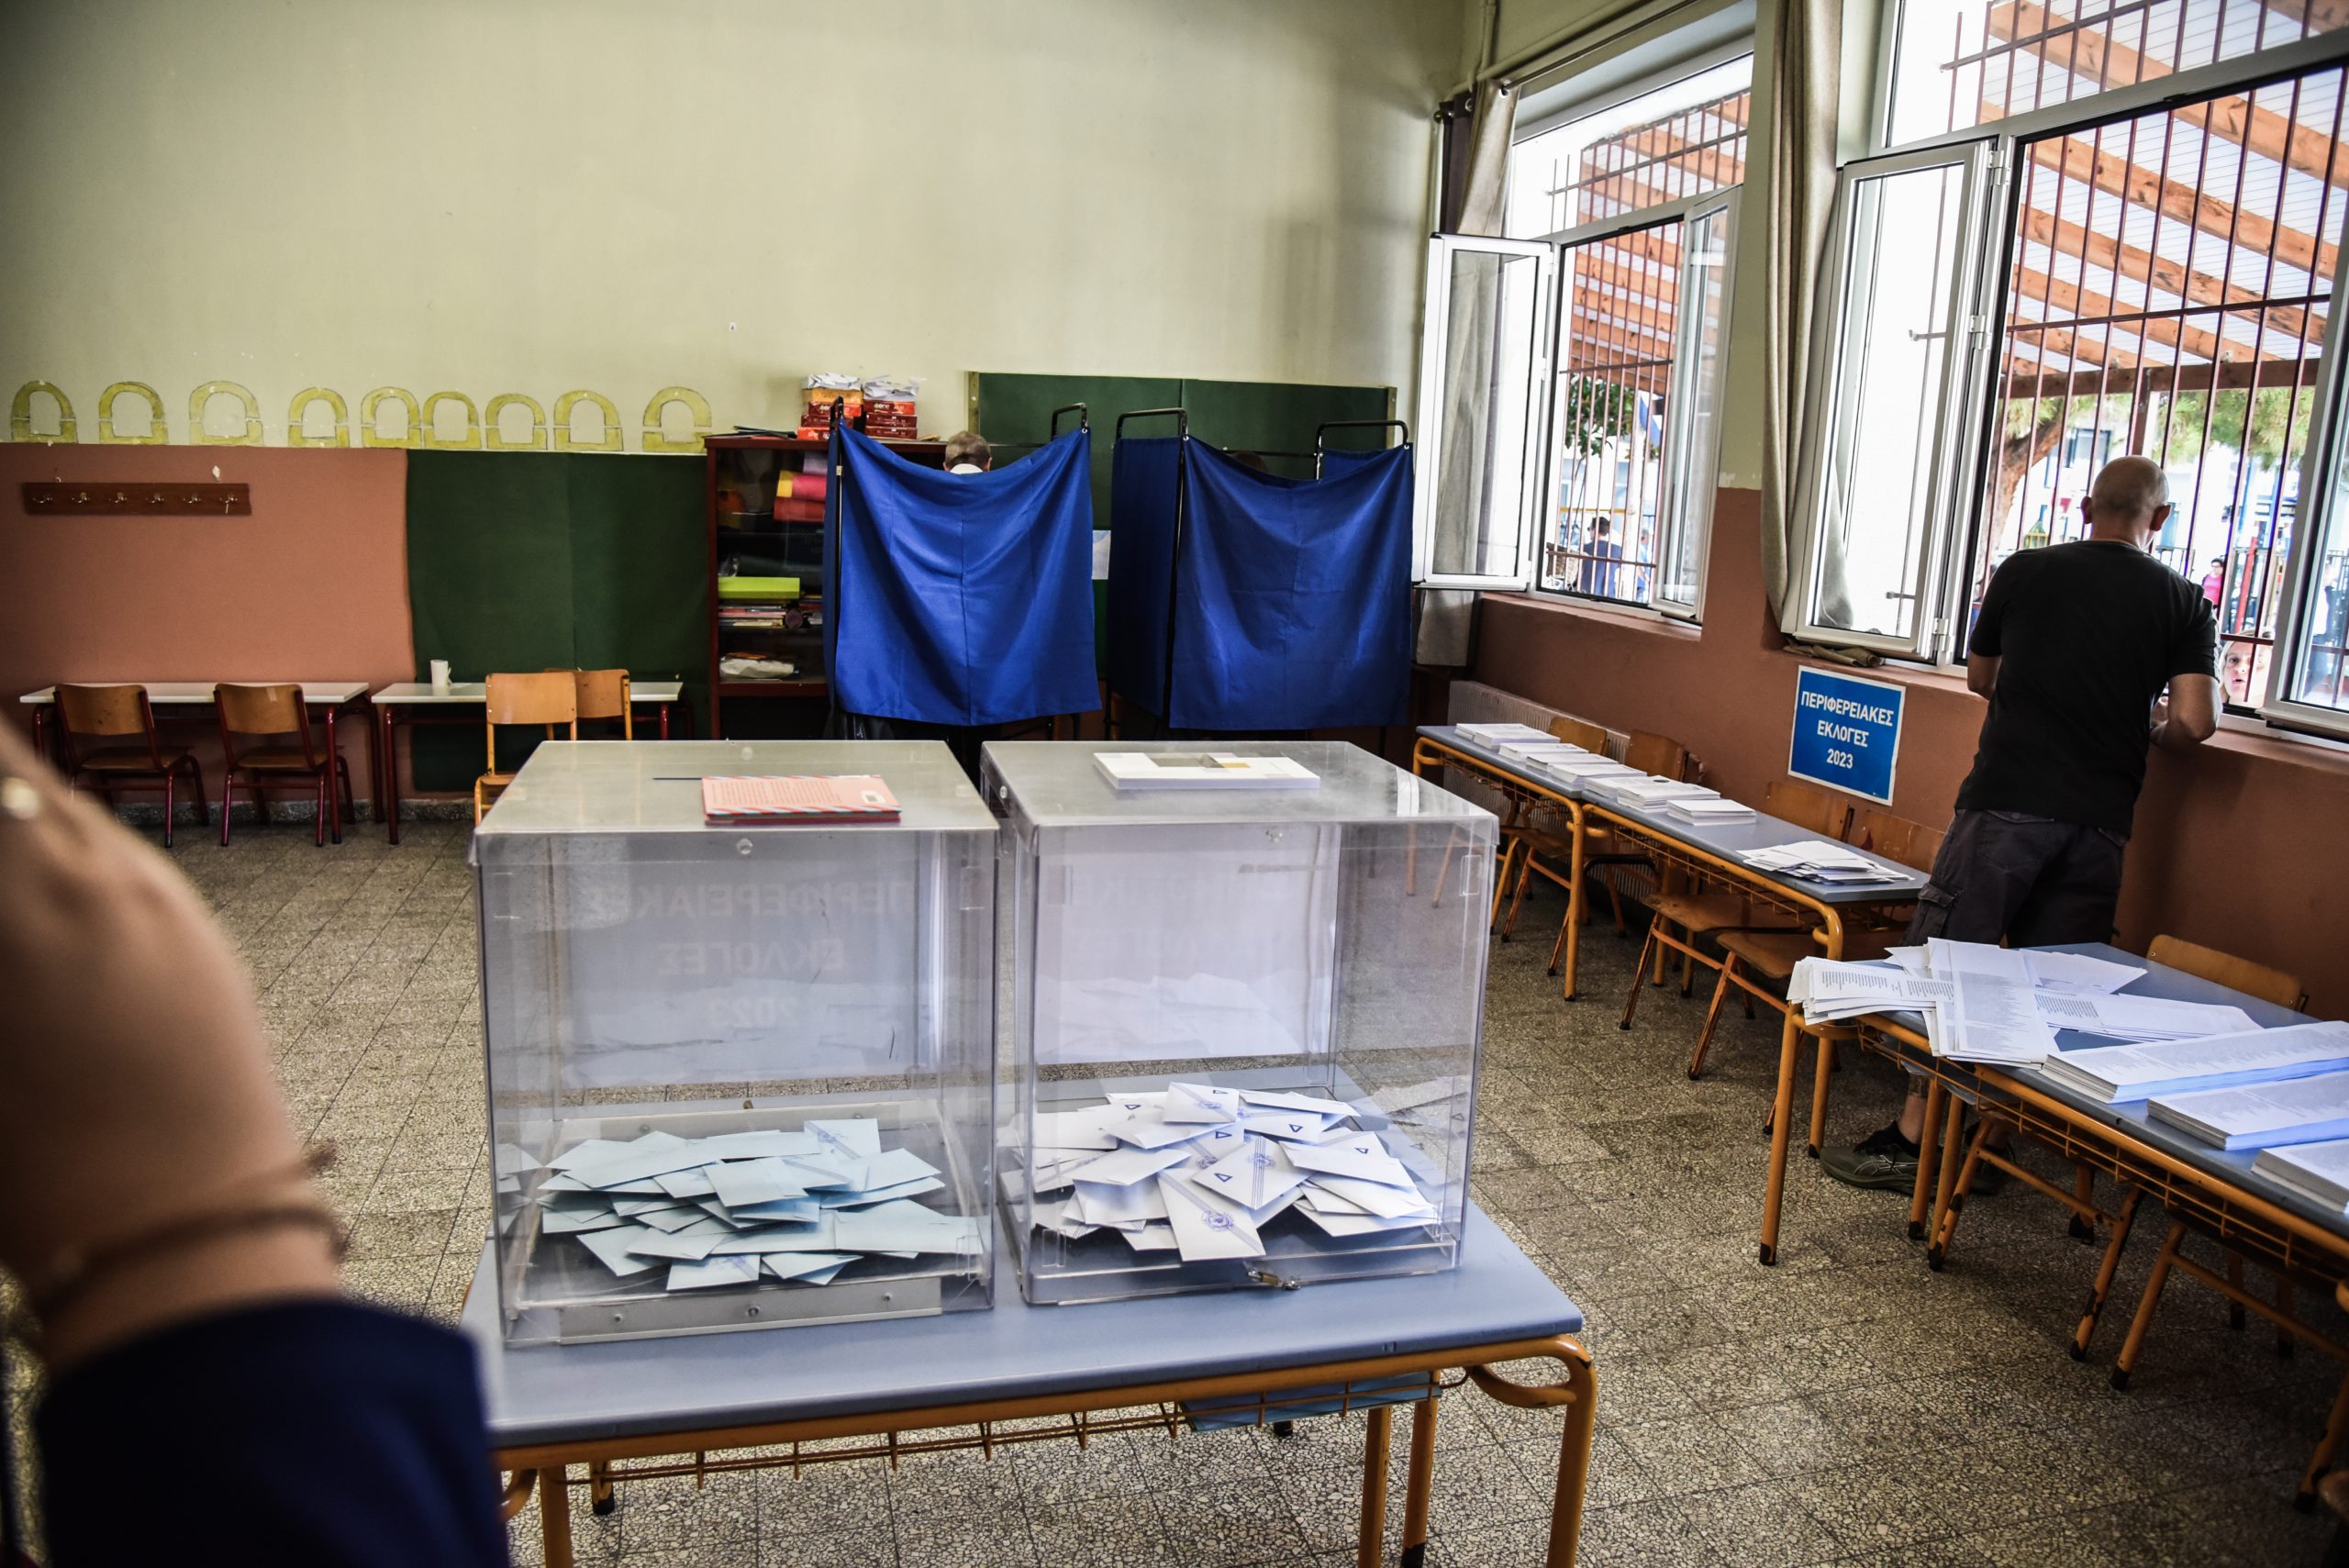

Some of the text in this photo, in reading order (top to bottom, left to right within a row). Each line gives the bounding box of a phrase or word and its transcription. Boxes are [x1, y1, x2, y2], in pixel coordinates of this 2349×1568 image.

[1800, 691, 1894, 727] ΠΕΡΙΦΕΡΕΙΑΚΕΣ
[1817, 720, 1869, 748] ΕΚΛΟΓΕΣ
[1826, 749, 1854, 769] 2023
